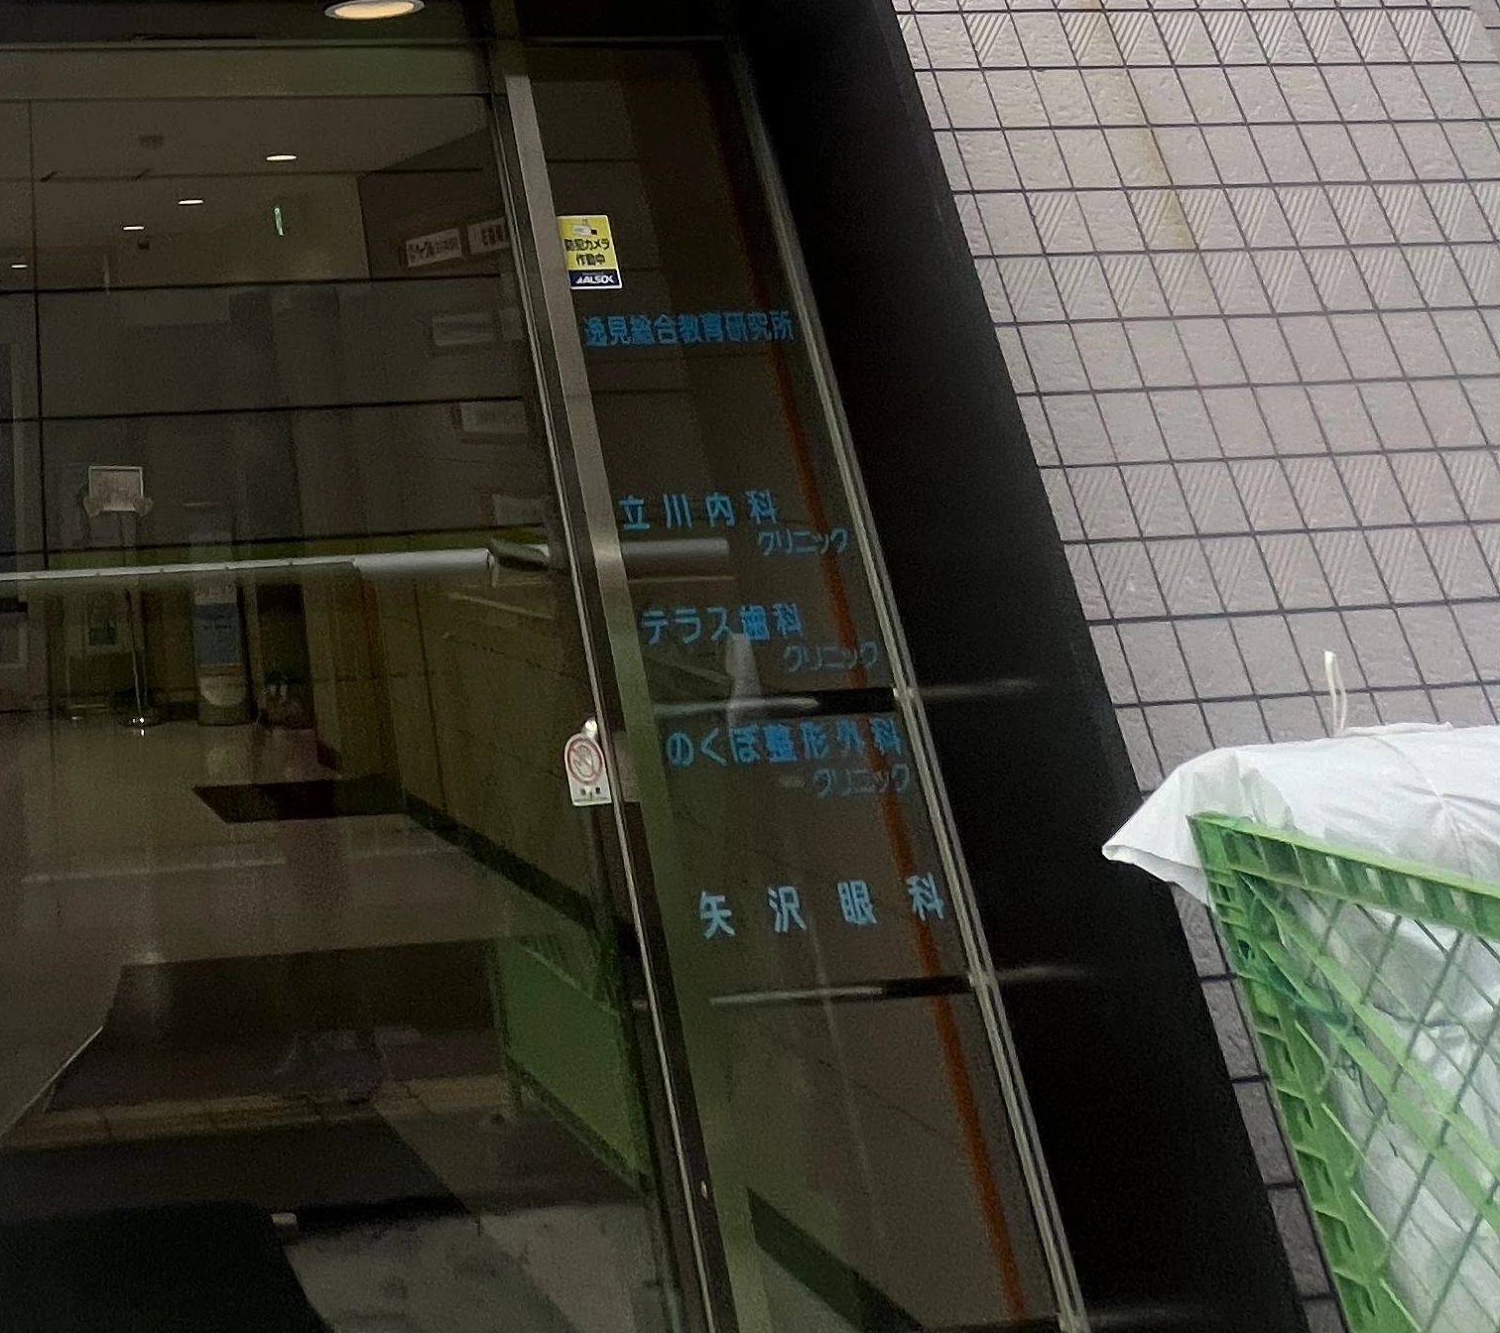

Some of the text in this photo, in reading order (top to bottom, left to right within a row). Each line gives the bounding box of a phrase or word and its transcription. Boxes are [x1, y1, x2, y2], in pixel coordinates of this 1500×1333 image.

[619, 490, 777, 530] 立川内科
[757, 529, 849, 555] クリニック
[641, 603, 802, 645] テラス歯科
[783, 642, 879, 671] クリニック
[666, 719, 902, 767] のくぼ整形外科
[812, 765, 912, 797] クリニック
[701, 872, 944, 939] 矢沢眼科
